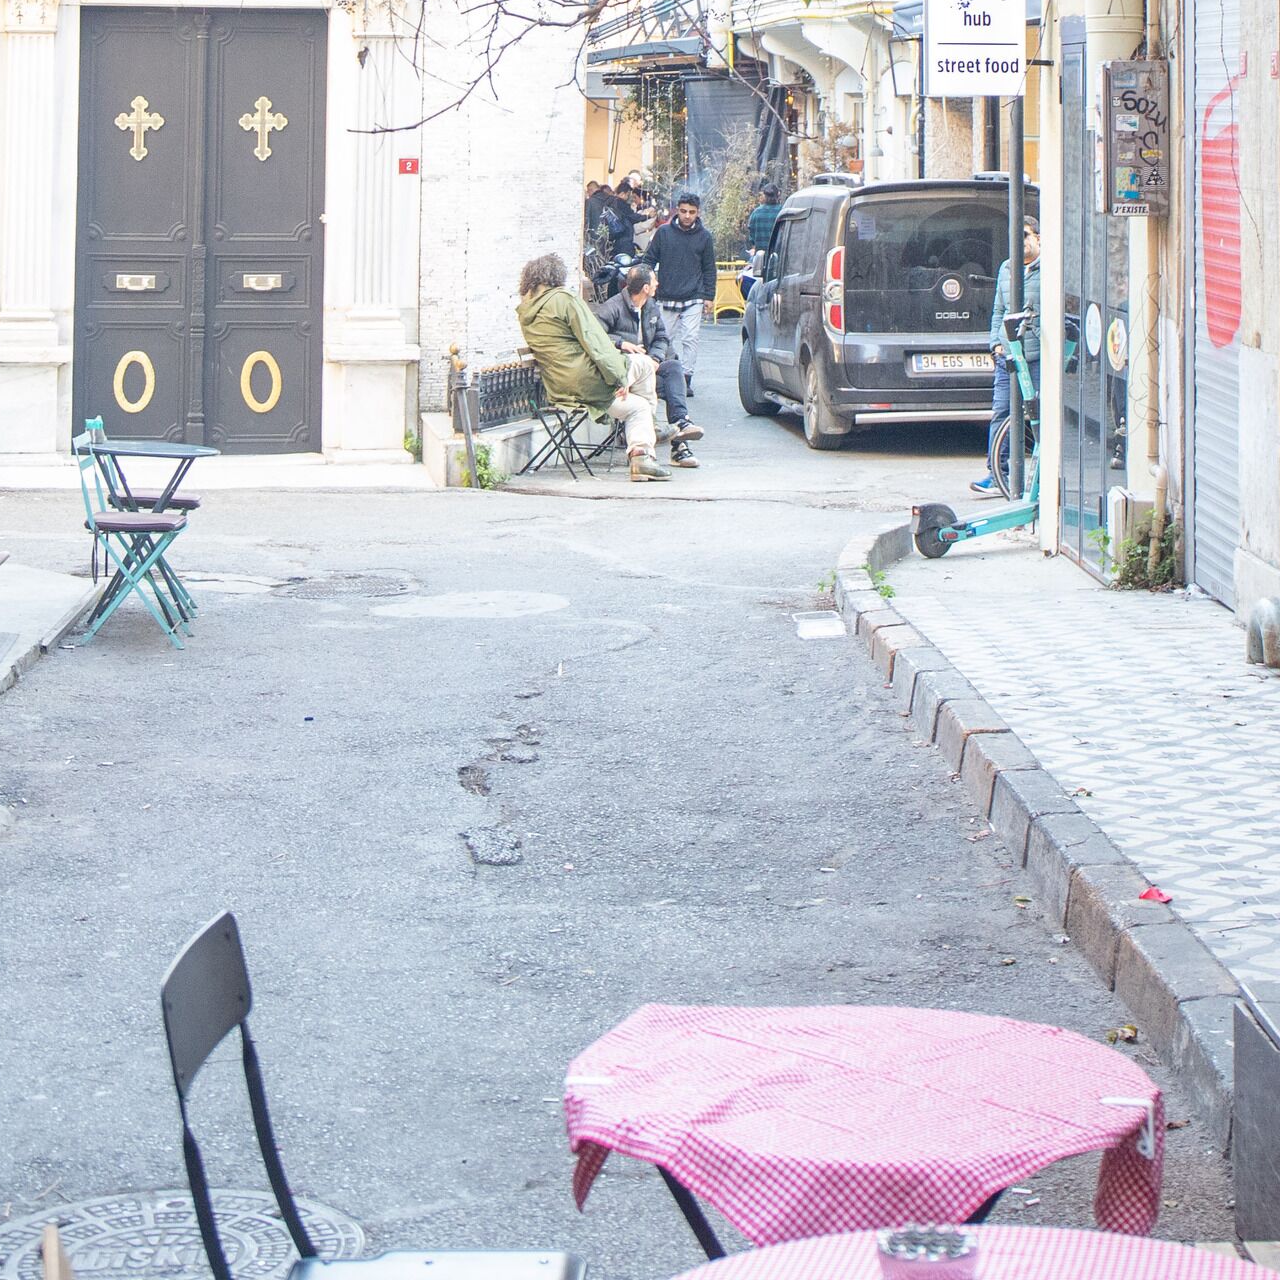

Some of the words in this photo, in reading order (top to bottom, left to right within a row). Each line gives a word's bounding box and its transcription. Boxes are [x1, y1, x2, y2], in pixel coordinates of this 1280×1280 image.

[964, 10, 991, 27] hub
[937, 58, 981, 73] street
[985, 57, 1019, 73] food
[406, 161, 412, 171] 2
[935, 311, 970, 320] DOBLO
[923, 356, 937, 368] 34
[942, 355, 964, 368] EGS
[969, 355, 990, 368] 184
